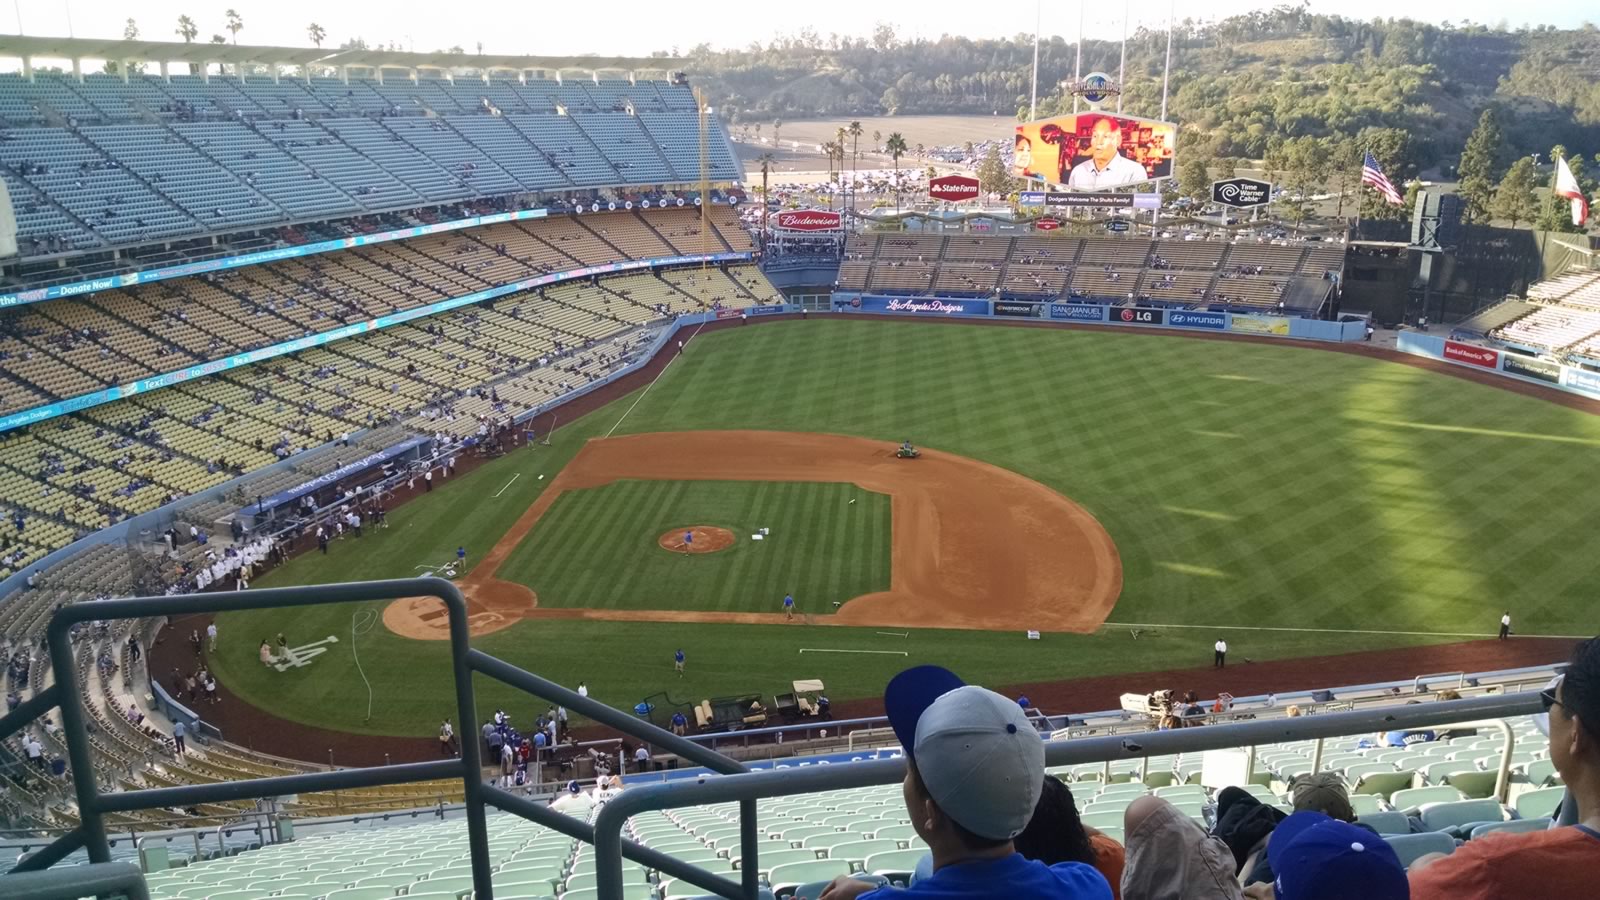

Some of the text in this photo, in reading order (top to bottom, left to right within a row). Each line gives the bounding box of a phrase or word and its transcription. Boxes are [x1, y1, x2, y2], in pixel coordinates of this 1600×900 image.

[942, 184, 977, 192] State Farm
[780, 215, 838, 226] Budweiser
[0, 296, 16, 305] the
[61, 282, 92, 295] Donate
[92, 278, 113, 290] Now!
[886, 298, 964, 314] Los Angeles Dodgers
[1052, 305, 1067, 313] SAN
[1073, 306, 1101, 315] MANUEL
[1136, 311, 1152, 321] LG
[1187, 316, 1225, 325] HYUNDAI
[1446, 346, 1457, 354] Bank
[1463, 350, 1482, 360] America
[144, 378, 164, 389] Text
